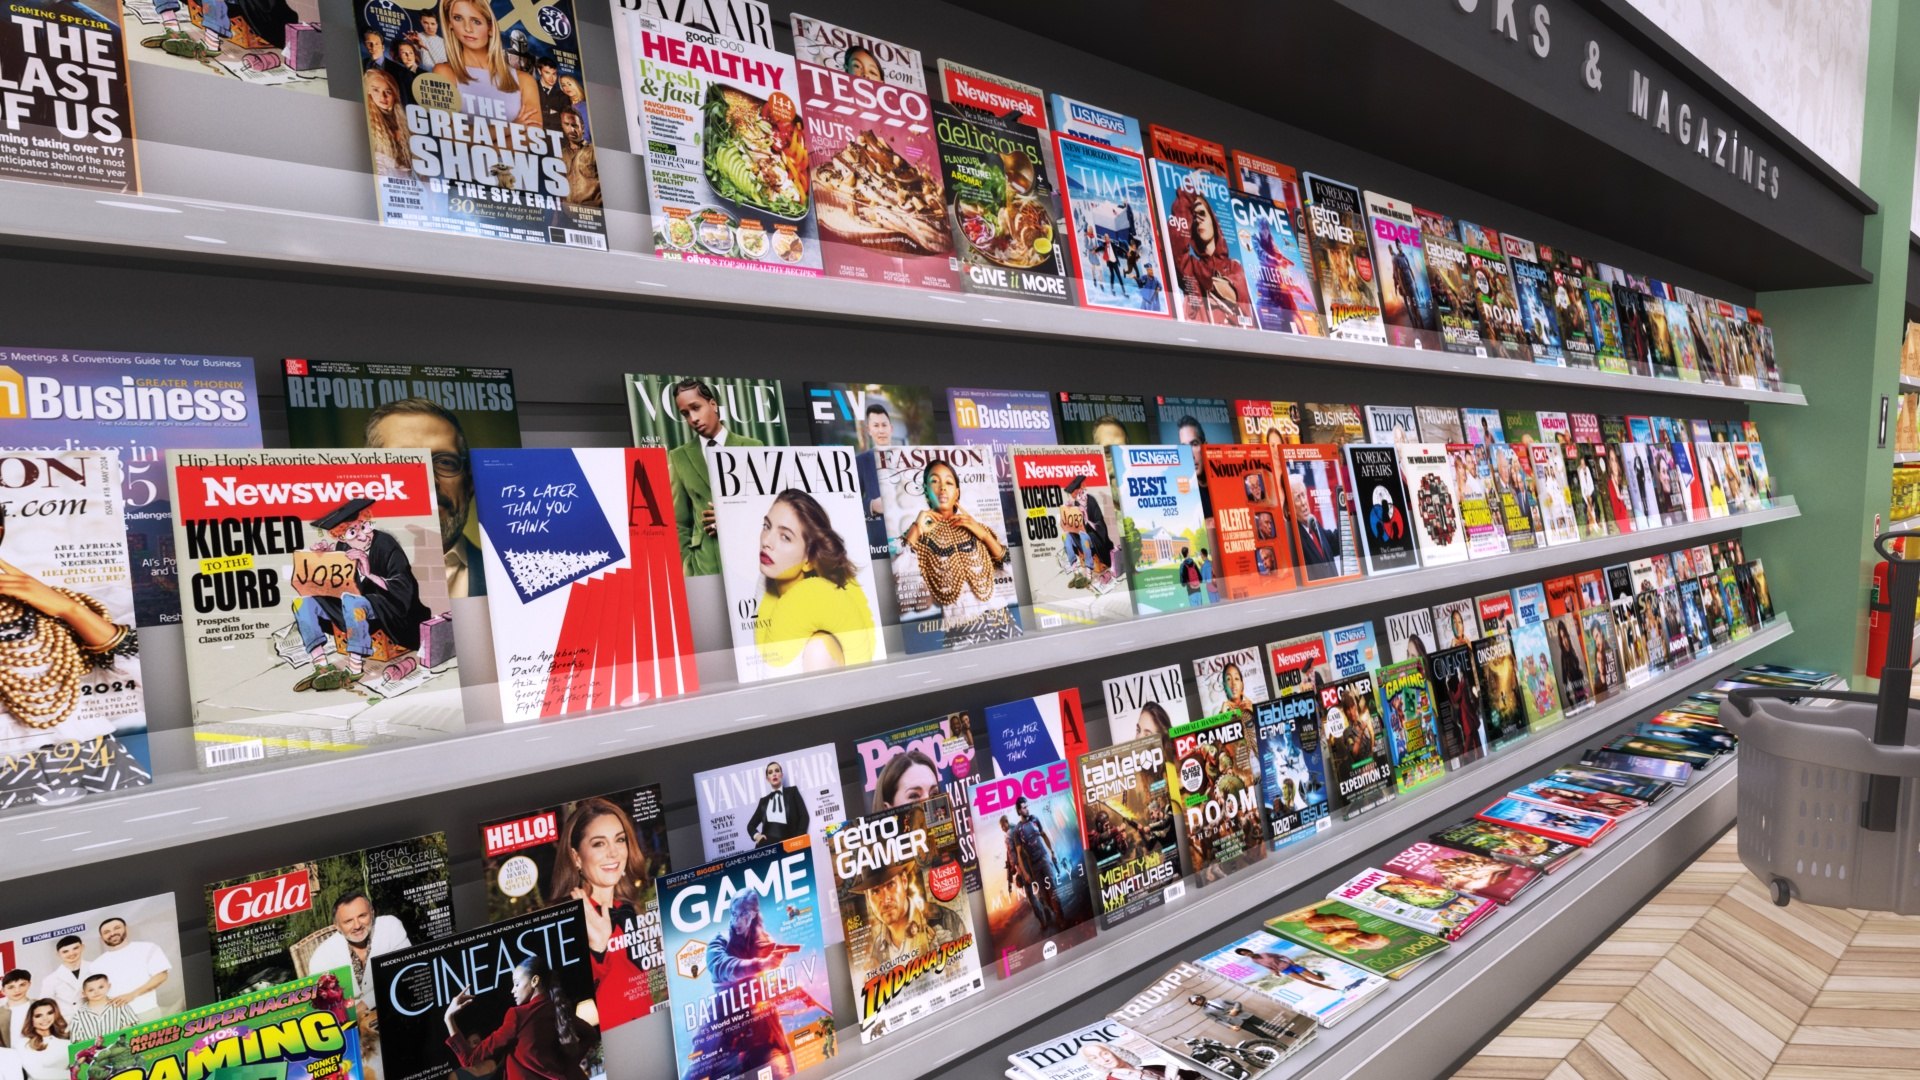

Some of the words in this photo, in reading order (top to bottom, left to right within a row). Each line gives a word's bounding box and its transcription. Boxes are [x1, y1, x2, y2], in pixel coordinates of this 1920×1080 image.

[10, 4, 56, 20] GAMING
[59, 14, 111, 31] SPECIAL
[11, 15, 117, 68] THE
[1457, 0, 1551, 58] KS
[1582, 40, 1602, 91] &
[639, 59, 701, 90] Fresh
[641, 31, 784, 90] HEALTHY
[640, 78, 659, 96] &
[656, 81, 702, 107] fast
[800, 63, 928, 121] TESCO
[955, 79, 1036, 117] Newsweek
[0, 92, 35, 130] F
[54, 101, 123, 143] US
[461, 94, 507, 120] THE
[405, 104, 564, 158] GREATEST
[808, 117, 856, 142] NUTS
[811, 136, 840, 150] ABOUT
[408, 134, 571, 197] SHOWS
[951, 171, 982, 187] AROMA!
[430, 177, 453, 194] OF
[455, 181, 489, 200] THE
[491, 187, 522, 205] SFX
[525, 192, 563, 211] ERA!
[1073, 165, 1138, 203] TIME
[1169, 214, 1188, 231] aya
[1231, 199, 1292, 236] GAME
[1310, 204, 1340, 225] retro
[1311, 219, 1355, 245] GAMER
[1375, 218, 1423, 249] EDGE
[1424, 239, 1468, 268] tabletop
[970, 267, 1009, 288] GIVE
[1010, 271, 1020, 289] it
[1022, 275, 1067, 295] MORE
[1483, 303, 1523, 326] DOOM
[136, 378, 188, 389] GREATER
[194, 380, 244, 390] PHOENIX
[288, 376, 374, 409] REPORT
[27, 376, 247, 421] Business
[1314, 411, 1361, 426] BUSINESS
[1420, 408, 1460, 425] TRIUMPH
[178, 453, 257, 471] Hip-Hop's
[260, 453, 315, 467] Favorite
[318, 453, 350, 466] New
[352, 452, 384, 466] York
[385, 452, 424, 468] Eatery
[877, 449, 984, 470] FASHION
[1024, 461, 1100, 480] Newsweek
[1355, 451, 1392, 464] FOREIGN
[1361, 464, 1393, 478] AFFAIRS
[716, 451, 857, 498] BAZAAR
[1127, 476, 1167, 497] BEST
[202, 474, 410, 507] Newsweek
[501, 484, 527, 499] IT'S
[533, 483, 579, 498] LATER
[629, 458, 668, 528] A
[1020, 485, 1064, 510] KICKED
[1138, 496, 1177, 508] COLLEGES
[502, 500, 541, 517] THAN
[546, 501, 572, 515] YOU
[1062, 510, 1084, 528] JOB?
[1219, 508, 1253, 532] ALERTE
[185, 515, 305, 560] KICKED
[507, 520, 550, 534] THINK
[1026, 516, 1059, 541] CURB
[204, 561, 221, 571] TO
[223, 558, 250, 569] THE
[296, 559, 355, 589] JOB?
[191, 568, 281, 614] CURB
[196, 616, 241, 627] Prospects
[737, 598, 759, 620] 02
[1520, 604, 1535, 618] BEST
[198, 634, 221, 644] Class
[223, 633, 234, 643] of
[235, 632, 255, 641] 2025
[205, 626, 219, 635] are
[221, 624, 239, 635] dim
[241, 623, 253, 633] for
[255, 622, 270, 631] the
[1390, 611, 1432, 643] BAZAAR
[1277, 646, 1321, 667] Newsweek
[1335, 650, 1359, 669] BEST
[81, 680, 136, 696] 2024
[1109, 668, 1183, 715] BAZAAR
[1385, 672, 1425, 698] GAMING
[1064, 698, 1082, 746] A
[1257, 697, 1315, 726] tabletop
[1002, 727, 1015, 739] IT'S
[1016, 722, 1040, 733] LATER
[1004, 739, 1022, 749] THAN
[1024, 735, 1037, 745] YOU
[1196, 723, 1243, 746] GAMER
[1082, 748, 1164, 788] tabletop
[1339, 769, 1381, 795] EXPEDITION
[1381, 764, 1391, 778] 33
[974, 762, 1070, 816] EDGE
[1085, 775, 1136, 804] GAMING
[1187, 786, 1258, 834] DOOM
[486, 815, 557, 851] HELLO!
[834, 816, 898, 854] retro
[696, 863, 724, 877] BIGGEST
[725, 856, 746, 869] GAMES
[747, 848, 777, 863] MAGAZINE
[836, 829, 929, 879] GAMER
[1387, 841, 1432, 869] TESCO
[932, 865, 957, 881] Master
[933, 877, 959, 891] System
[1100, 860, 1146, 887] MIGHTY
[1102, 861, 1174, 904] MINIATURES
[1339, 871, 1385, 899] HEALTHY
[217, 877, 309, 924] Gala
[670, 852, 810, 933] GAME
[631, 944, 659, 960] LIKE
[389, 917, 580, 1017] CINEASTE
[684, 965, 797, 1032] BATTLEFIELD
[802, 955, 817, 983] V
[862, 950, 938, 1030] INDIANA
[936, 935, 973, 974] JONES
[1114, 965, 1199, 1022] TRIUMPH
[183, 1005, 248, 1037] SUPER
[250, 986, 319, 1020] HACKS!
[710, 1018, 730, 1031] World
[731, 1013, 744, 1024] War
[200, 1026, 239, 1047] 110%
[1025, 1023, 1120, 1069] music
[307, 1054, 342, 1073] DONKEY
